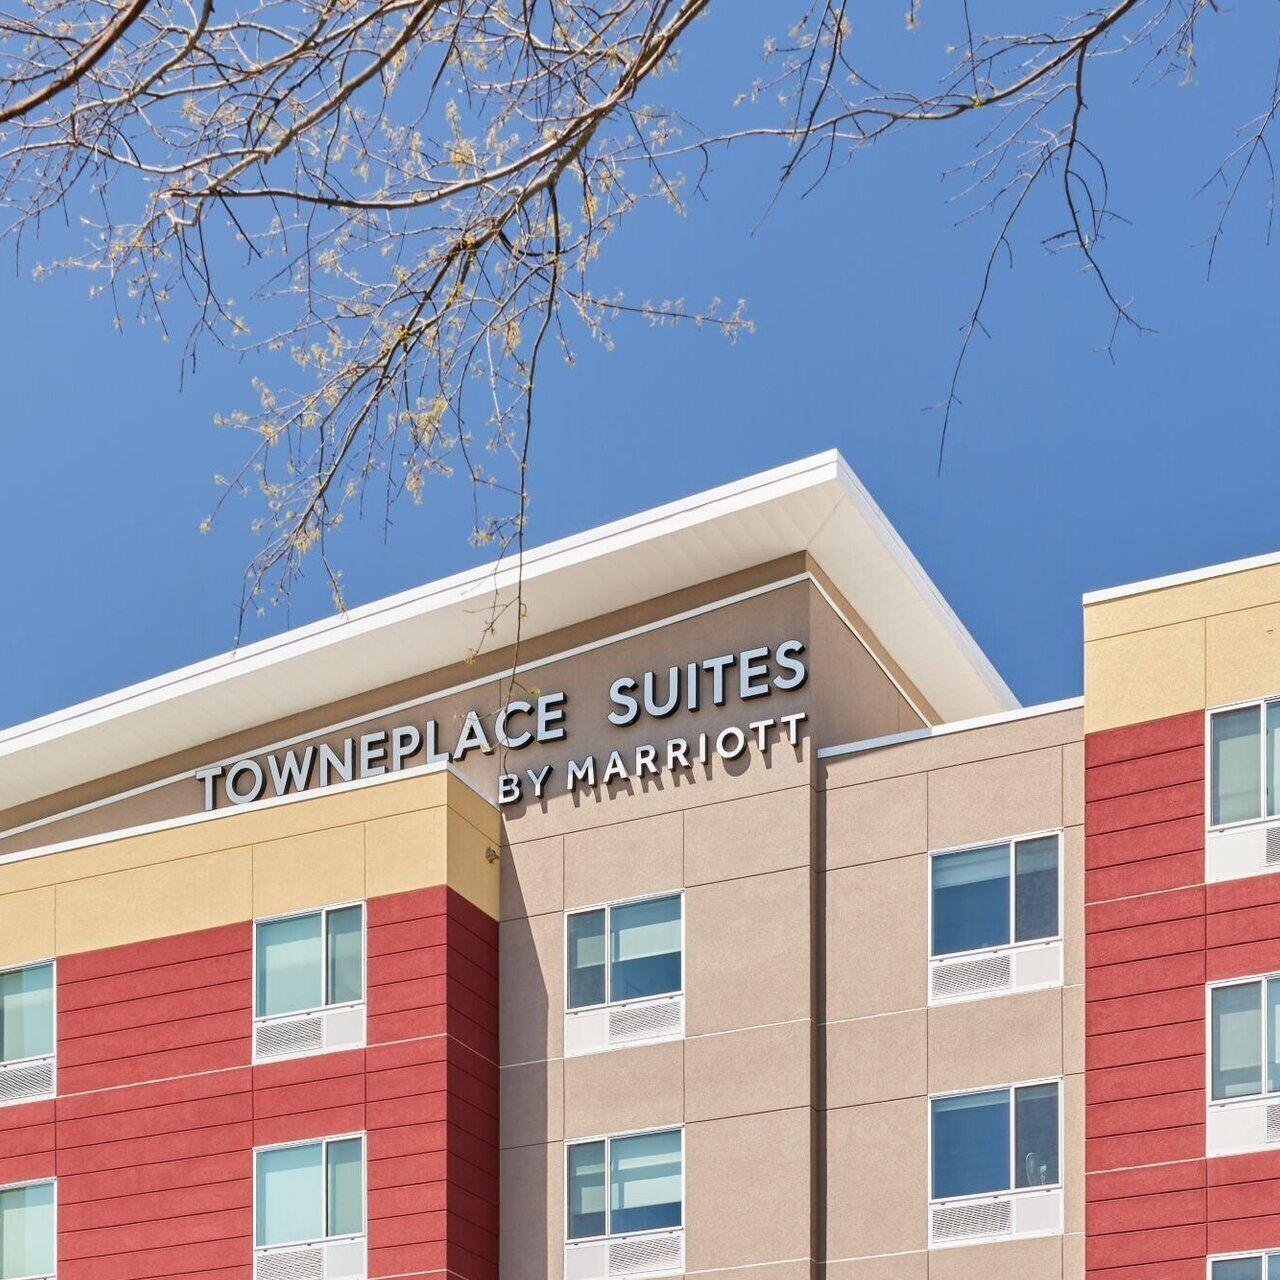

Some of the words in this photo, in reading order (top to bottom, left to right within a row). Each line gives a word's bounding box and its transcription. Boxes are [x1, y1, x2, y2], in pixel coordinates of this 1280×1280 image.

[195, 692, 567, 810] TOWNEPLACE
[607, 640, 808, 727] SUITES
[497, 763, 554, 805] BY
[566, 711, 807, 791] MARRIOTT
